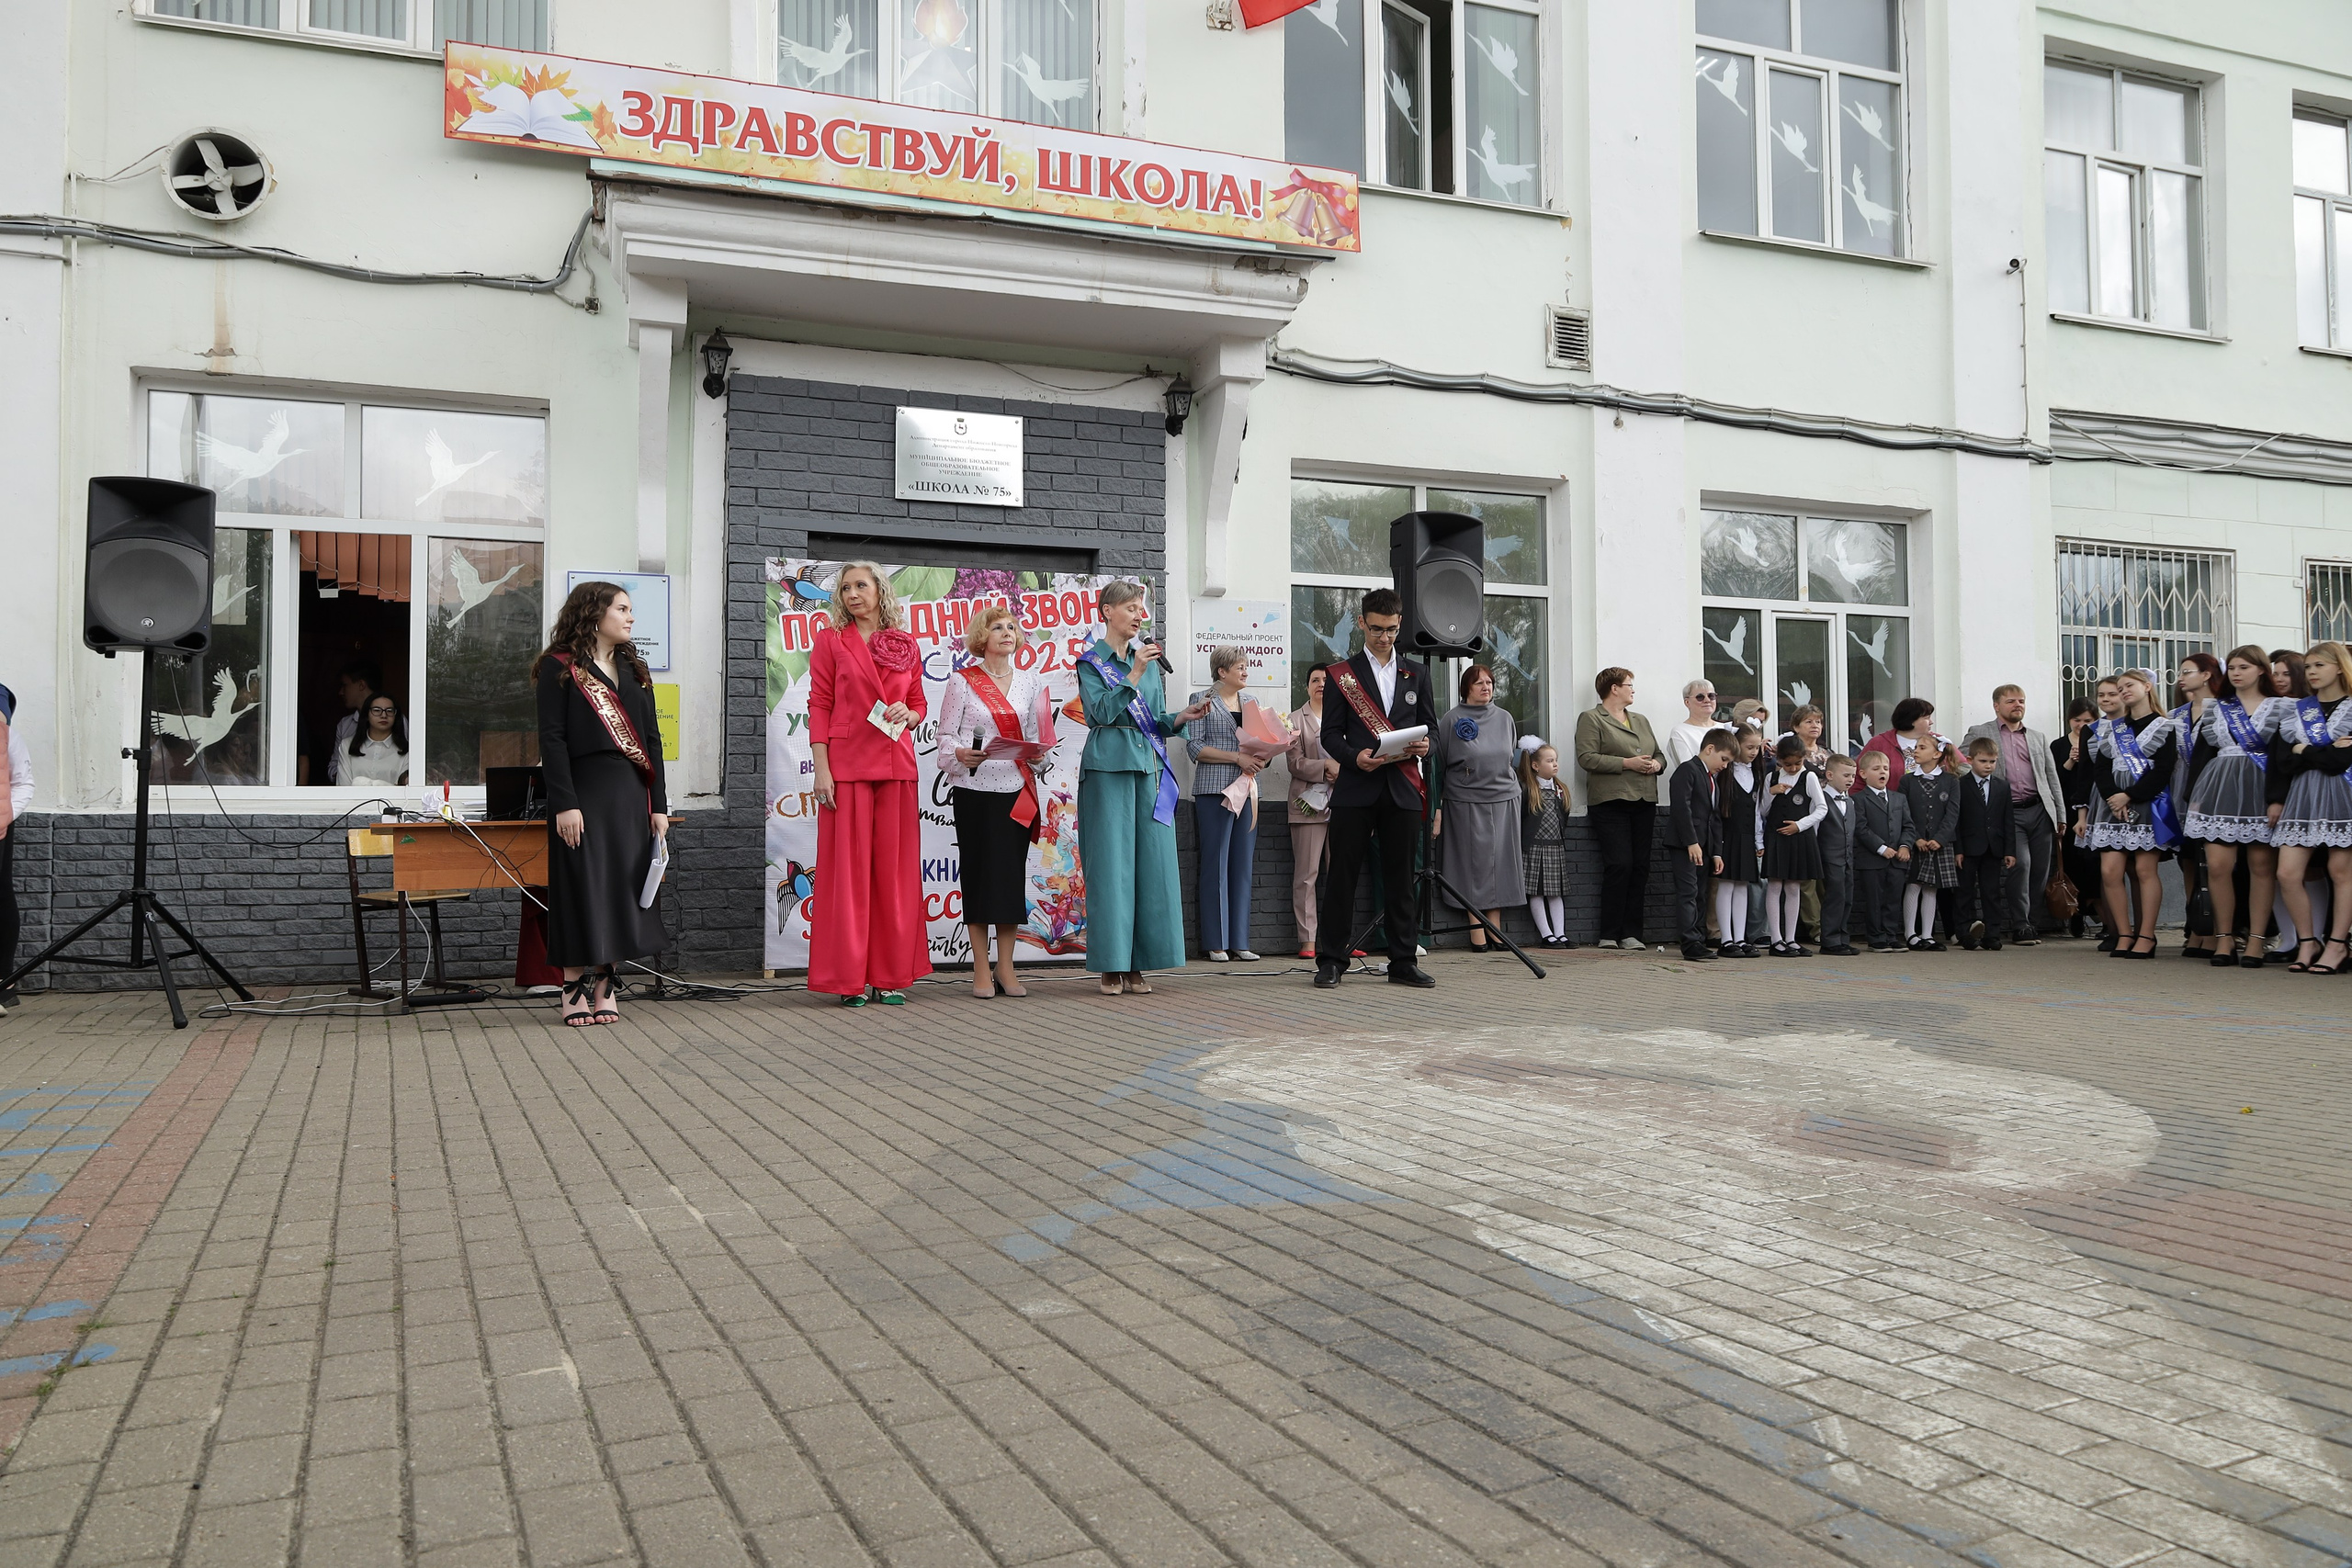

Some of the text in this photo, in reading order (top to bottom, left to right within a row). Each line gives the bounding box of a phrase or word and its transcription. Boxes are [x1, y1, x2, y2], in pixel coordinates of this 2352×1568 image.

[619, 90, 1263, 220] ЗДРАВСТВУЙ, ШКОЛА!
[921, 461, 1000, 472] ОБЩЕОБРАЗОВАТЕЛЬНОЕ
[938, 468, 983, 477] УЧРЕЖДЕНИЕ
[908, 480, 1012, 497] «ШКОЛА № 75»
[1195, 632, 1283, 642] ФЕДЕРАЛЬНЫЙ ПРОЕКТ
[1013, 637, 1086, 674] 025
[1236, 646, 1283, 656] АЖДОГО
